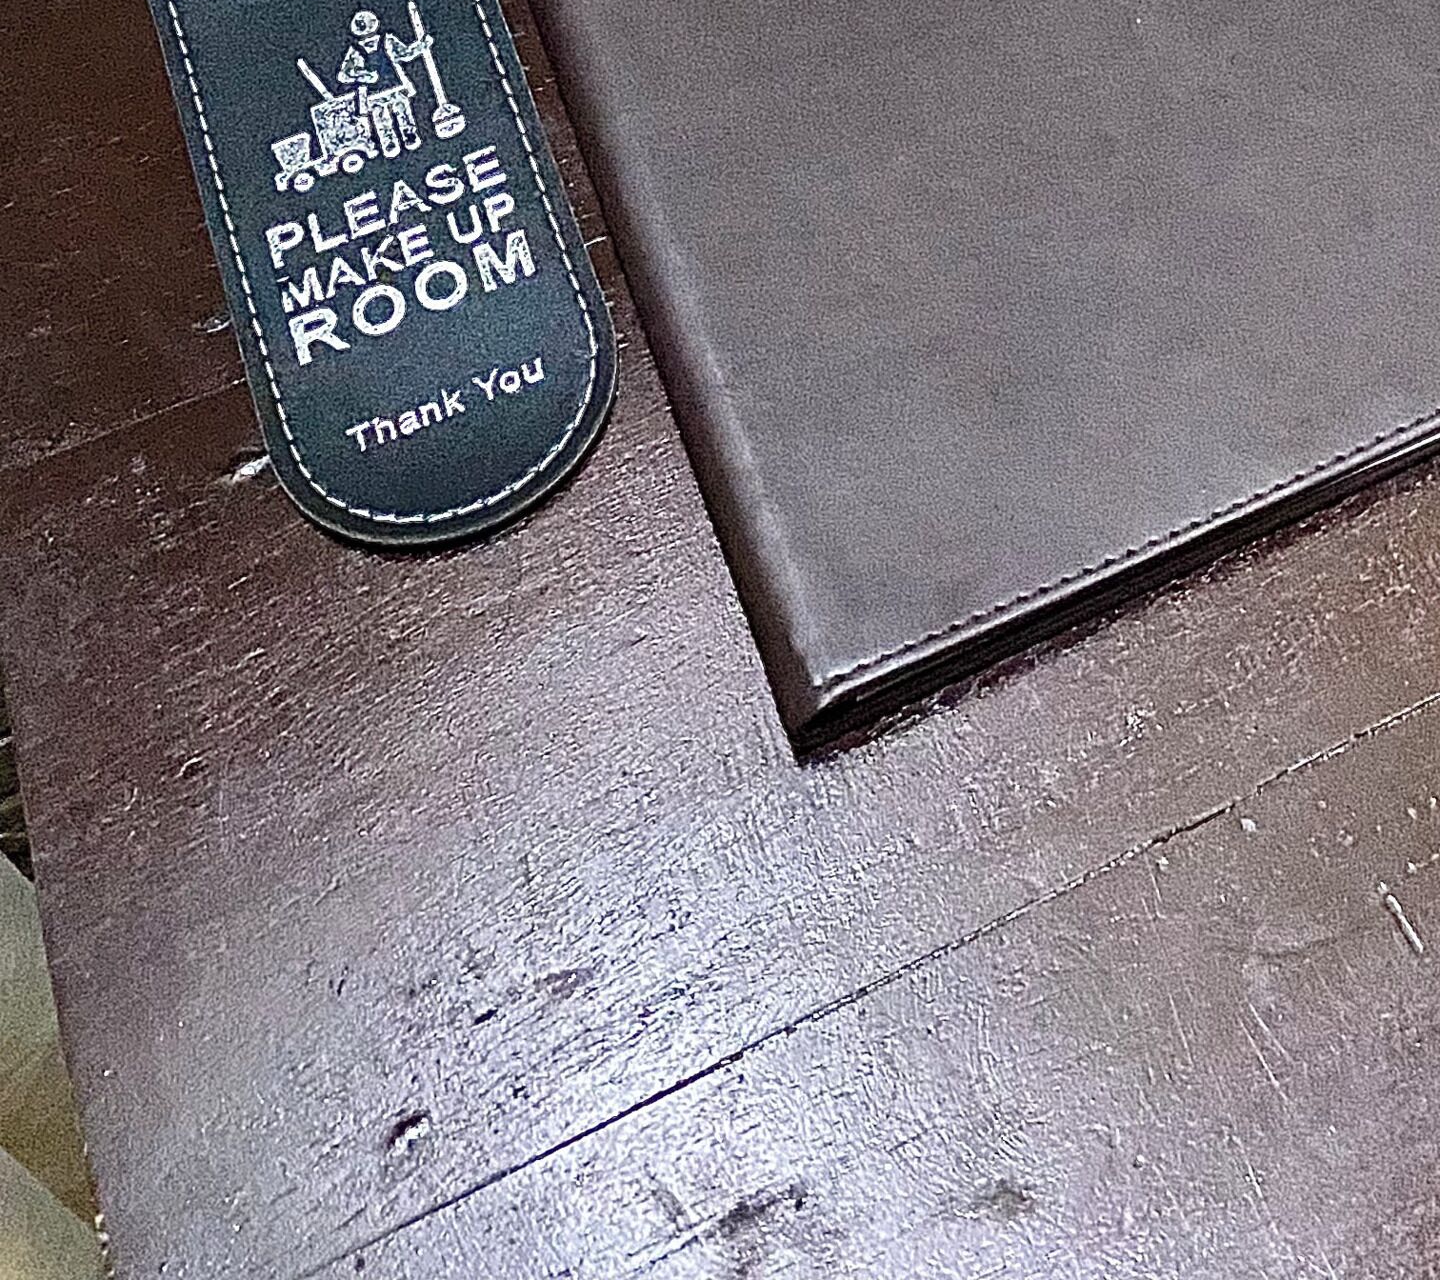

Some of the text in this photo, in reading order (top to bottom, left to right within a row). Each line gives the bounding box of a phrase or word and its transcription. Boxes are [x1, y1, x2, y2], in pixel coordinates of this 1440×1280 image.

[265, 144, 507, 269] PLEASE
[276, 191, 517, 313] MAKE UP
[288, 228, 536, 366] ROOM
[345, 356, 546, 453] Thank You
